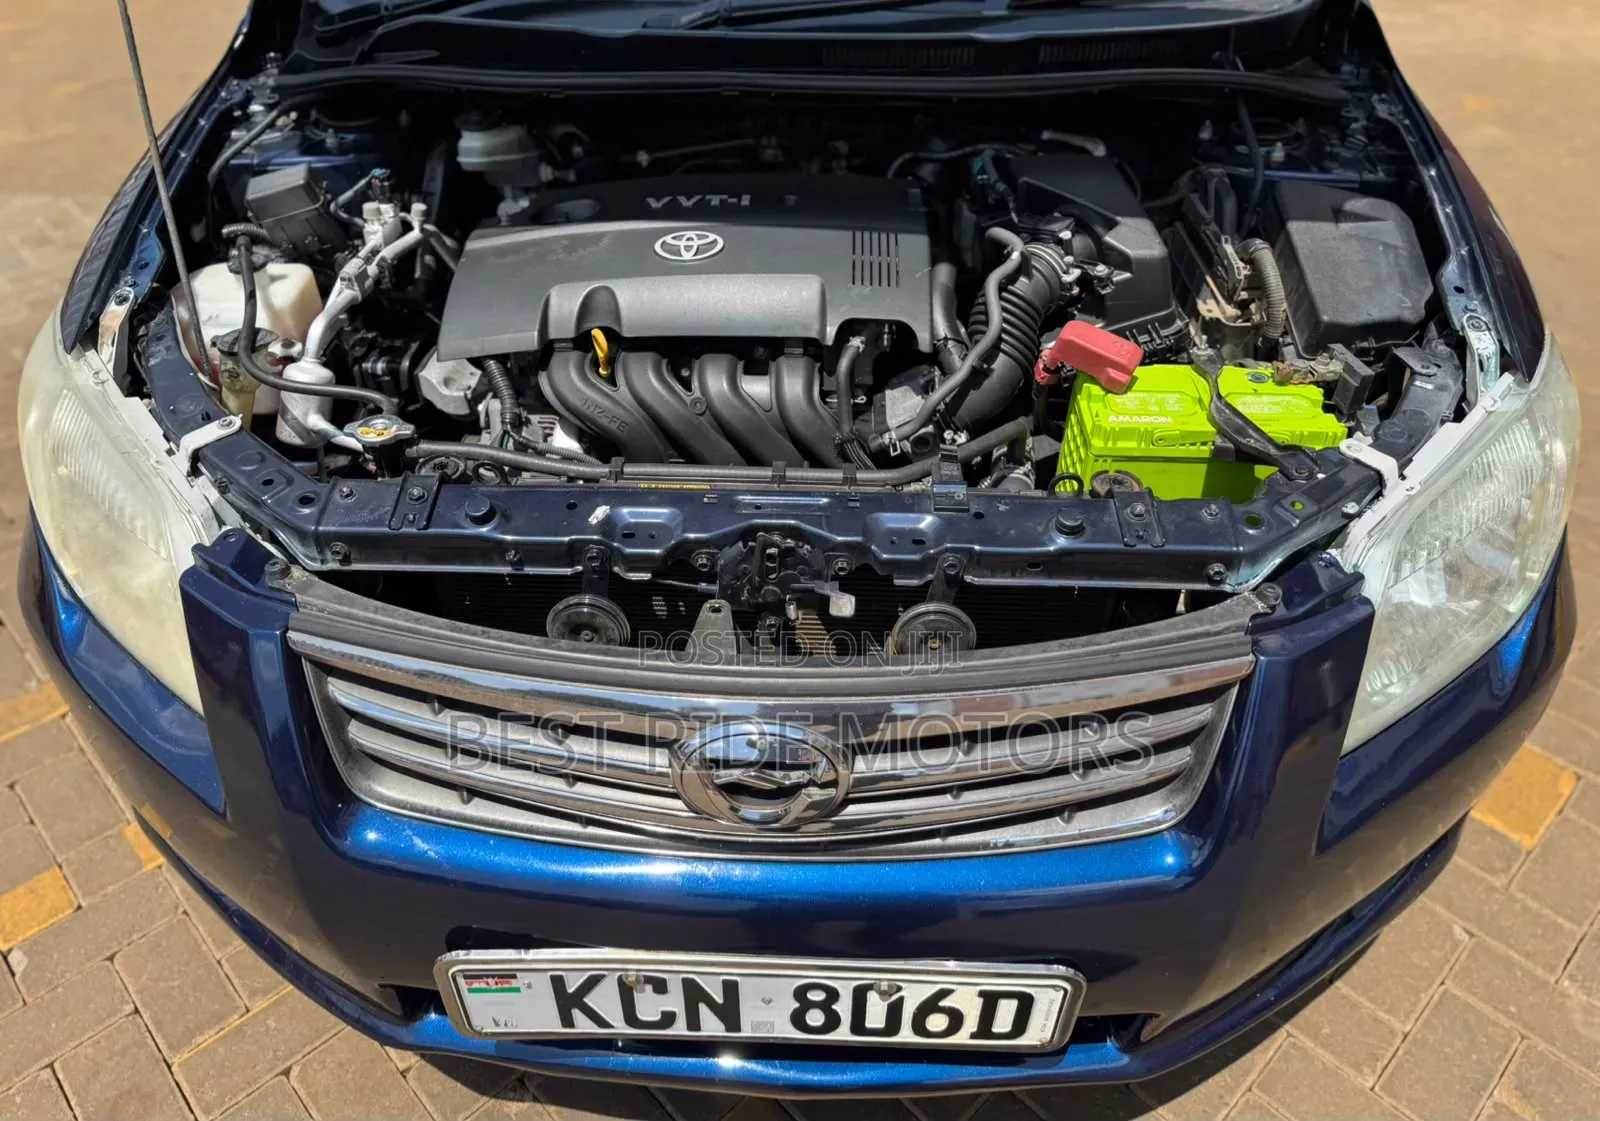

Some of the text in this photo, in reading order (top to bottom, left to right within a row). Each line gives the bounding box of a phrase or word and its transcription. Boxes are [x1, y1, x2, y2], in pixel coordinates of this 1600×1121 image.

[1108, 414, 1173, 423] AMARON
[550, 972, 742, 1033] KCN
[789, 981, 1035, 1041] 806D
